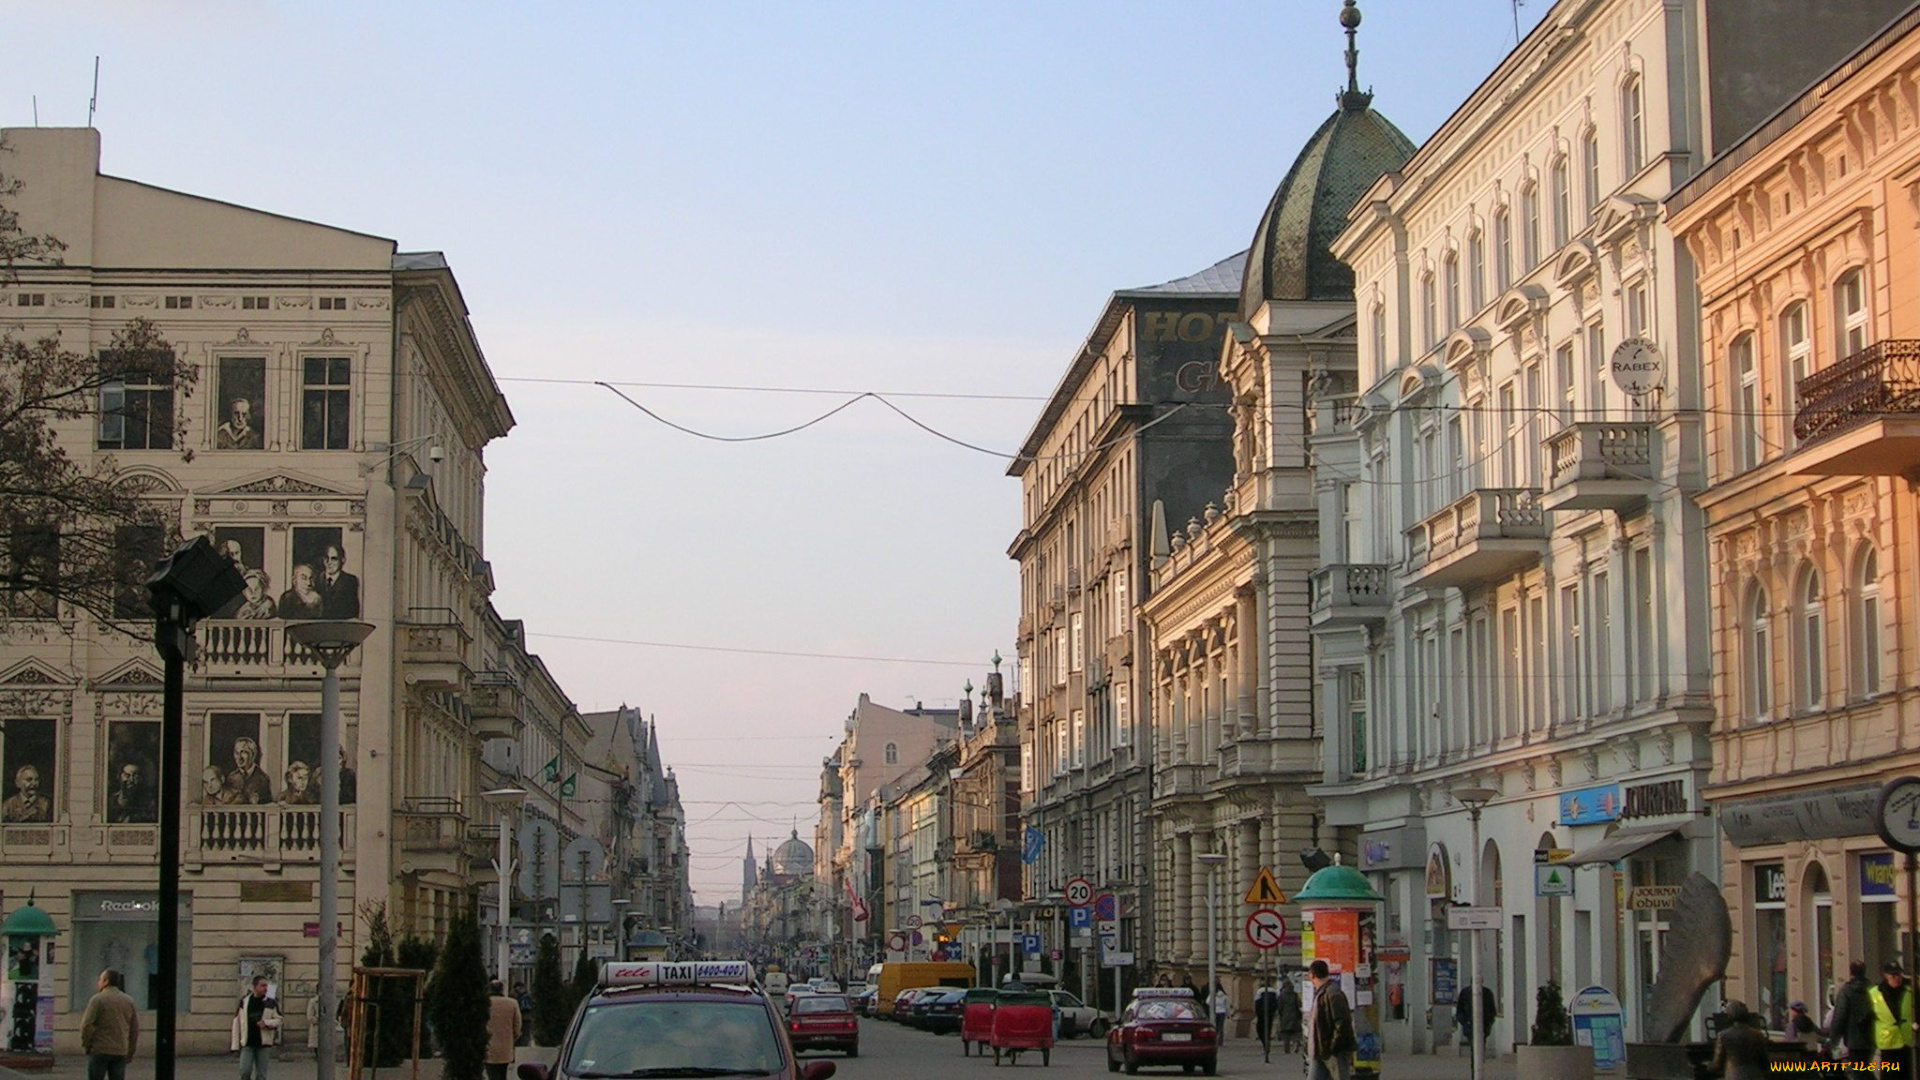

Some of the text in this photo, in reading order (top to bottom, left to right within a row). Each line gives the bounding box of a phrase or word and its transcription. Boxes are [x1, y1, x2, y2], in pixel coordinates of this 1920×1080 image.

[1613, 361, 1660, 372] RABEX
[1622, 780, 1687, 819] JOURNAL
[1768, 869, 1785, 899] Lee
[1071, 886, 1088, 899] 20
[1073, 908, 1086, 926] P
[1025, 936, 1037, 952] P
[663, 966, 692, 979] TAXI
